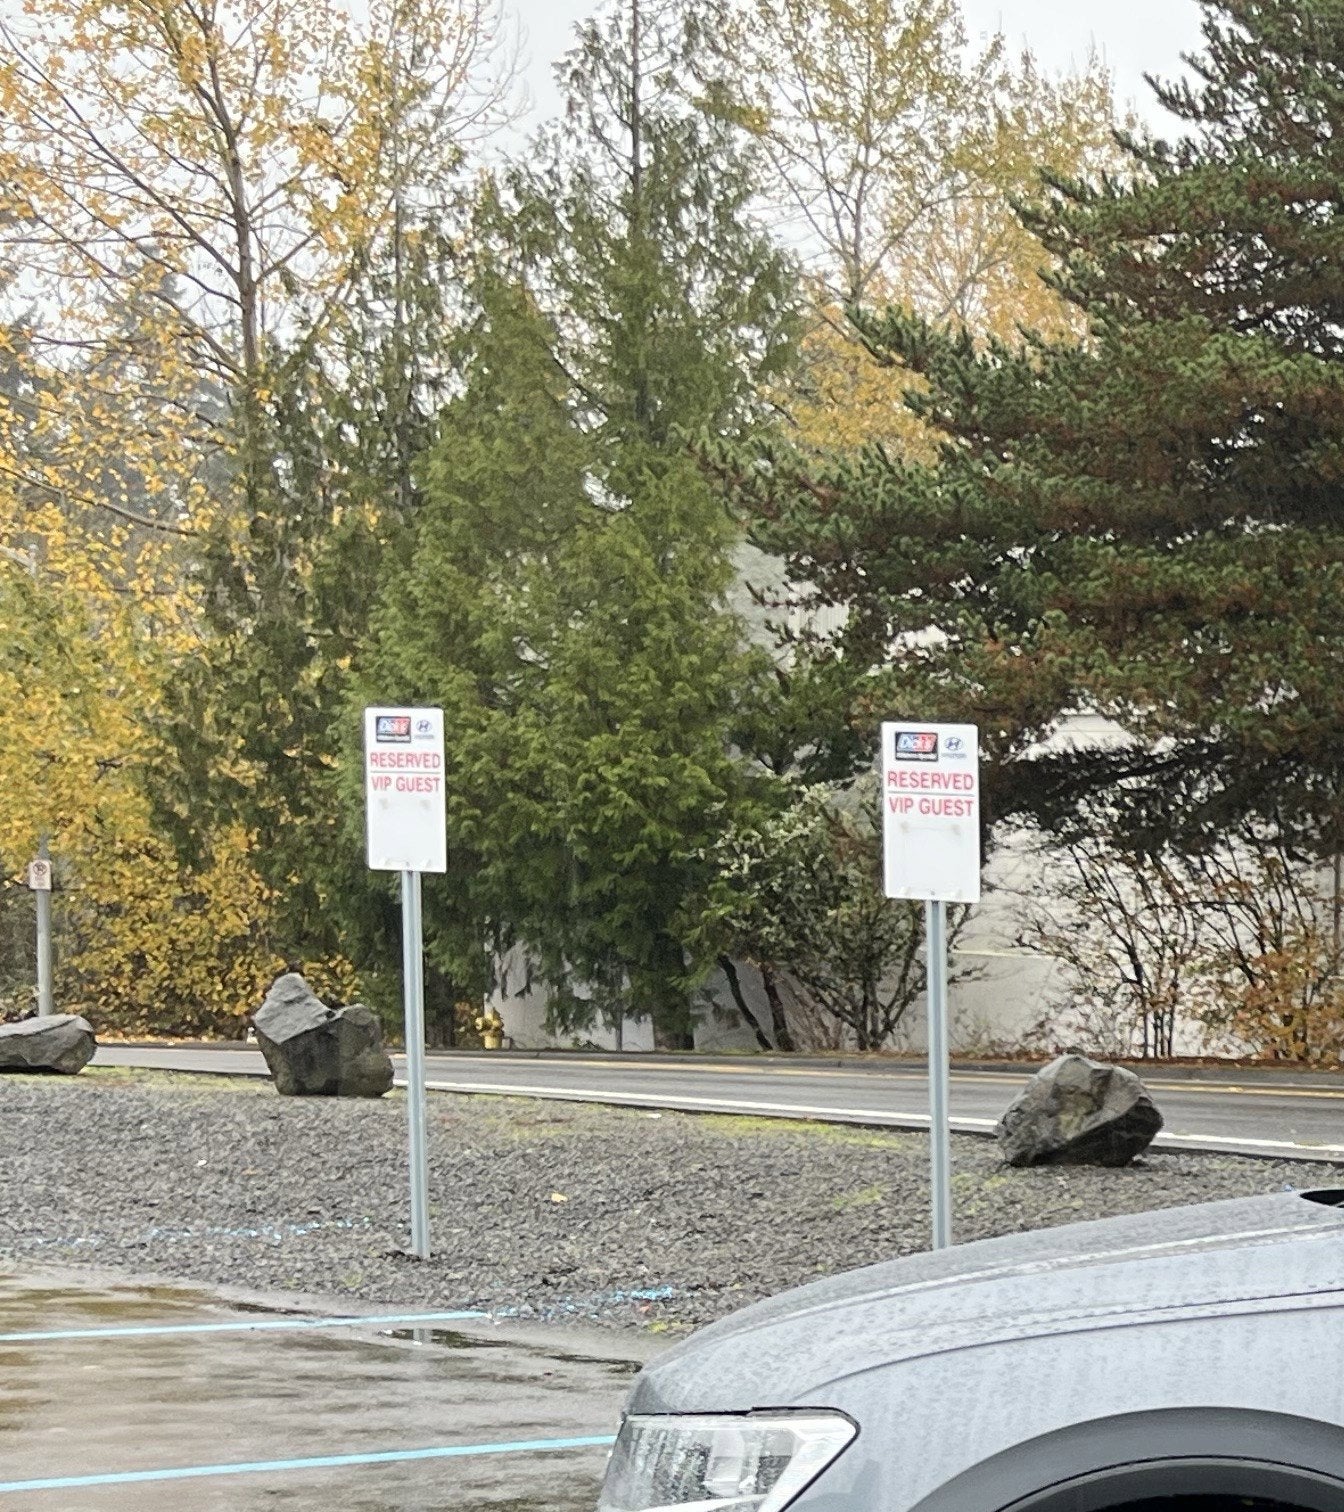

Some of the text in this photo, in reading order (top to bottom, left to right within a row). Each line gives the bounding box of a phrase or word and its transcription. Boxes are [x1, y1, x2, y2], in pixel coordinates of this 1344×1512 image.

[370, 752, 441, 769] RESERVED
[371, 776, 441, 793] VIP GUEST
[888, 771, 974, 791] RESERVED
[889, 797, 975, 816] VIP GUEST
